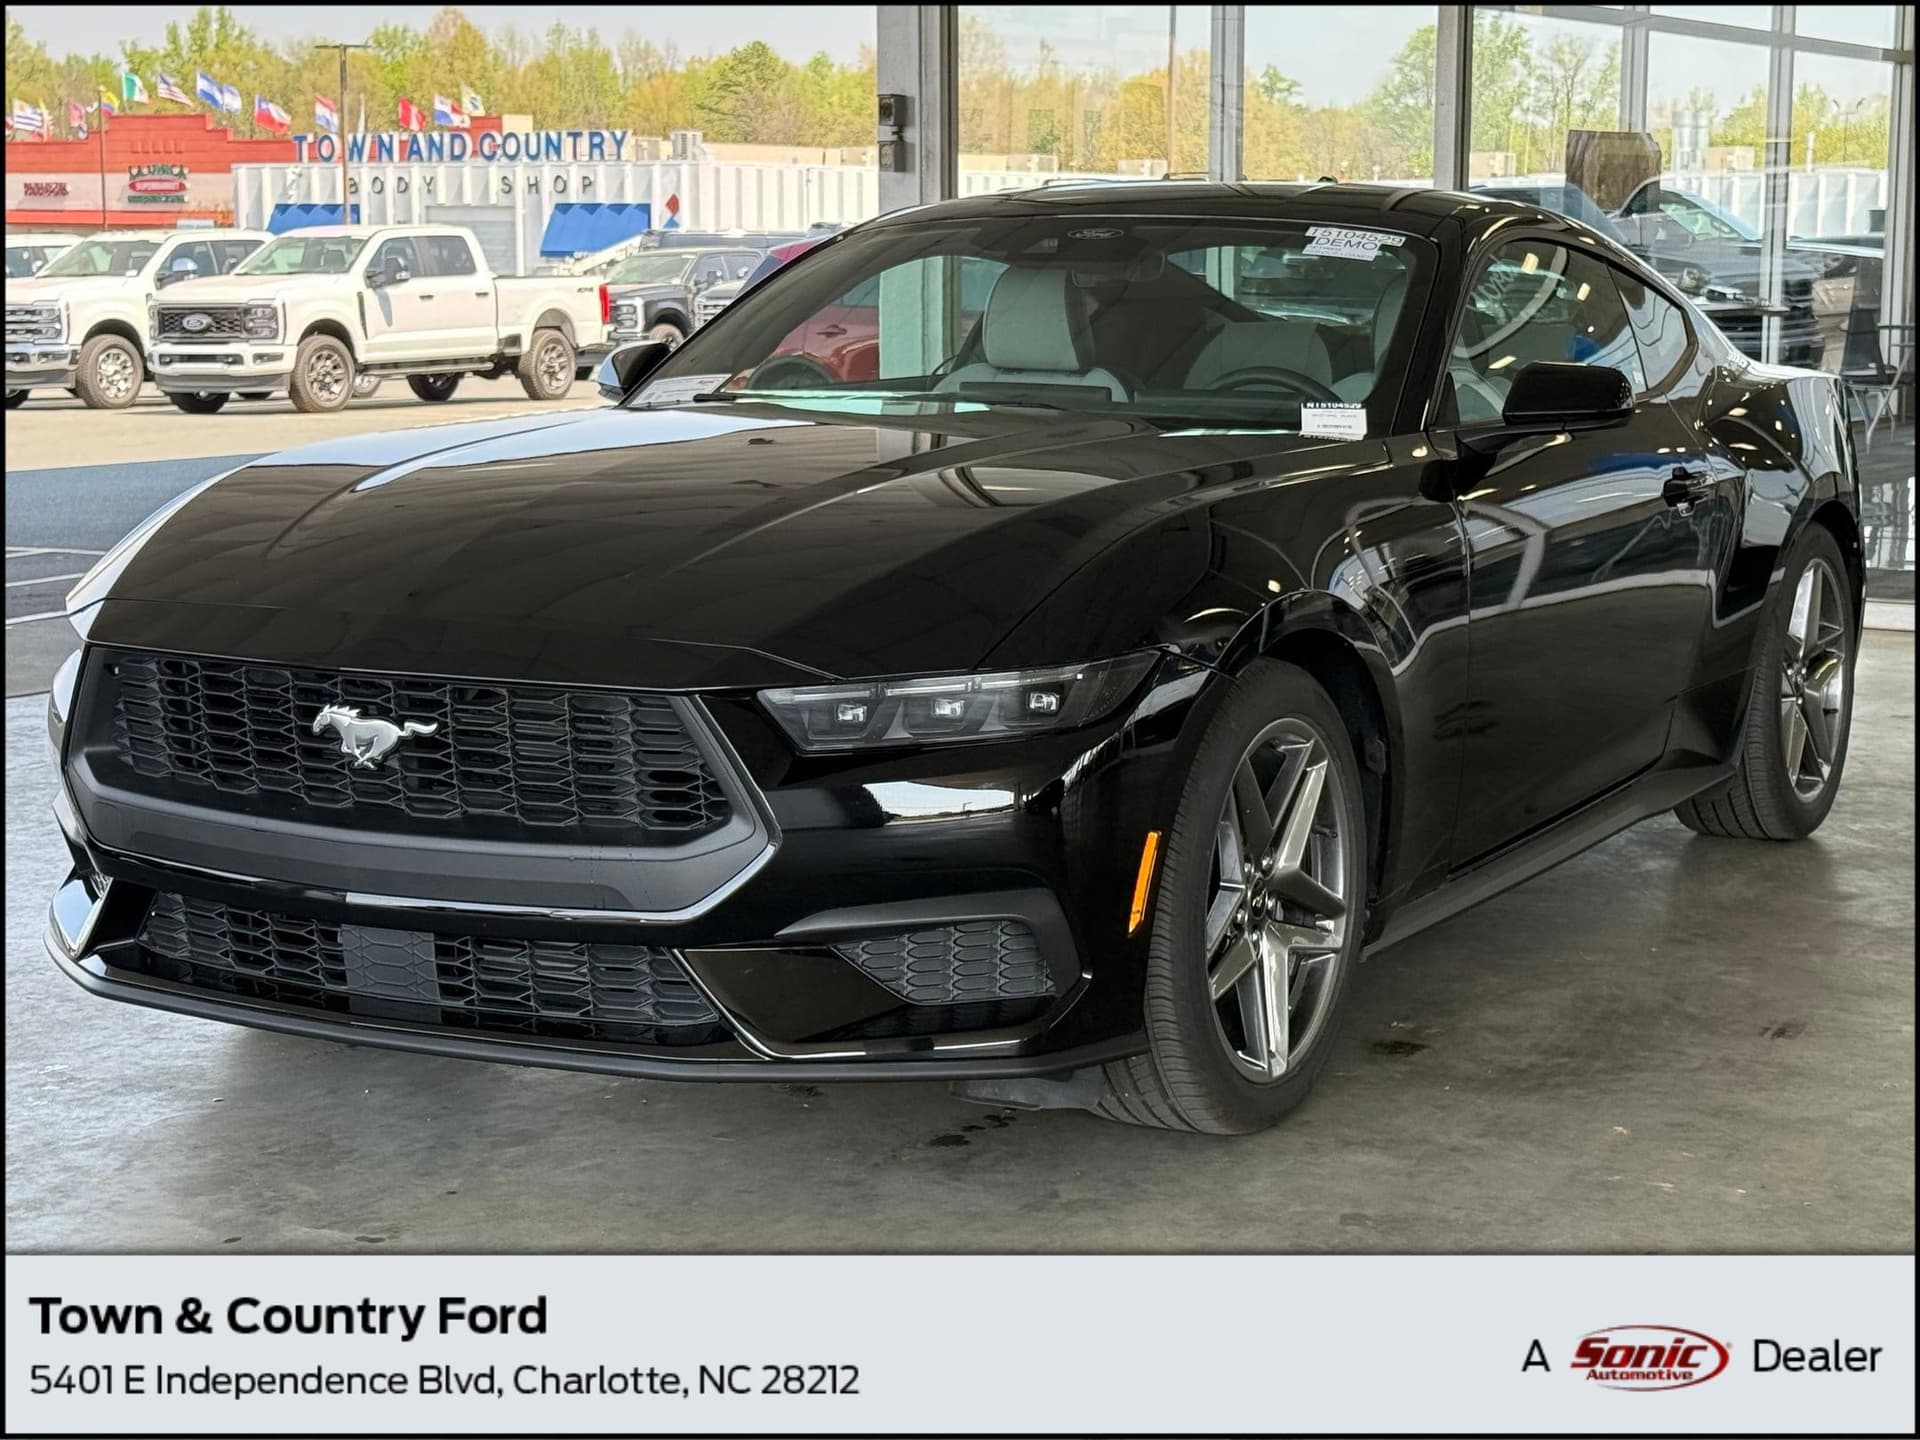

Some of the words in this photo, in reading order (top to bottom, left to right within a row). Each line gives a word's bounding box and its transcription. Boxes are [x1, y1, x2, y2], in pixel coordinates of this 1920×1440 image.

[293, 133, 394, 162] TOWN
[407, 132, 468, 161] AND
[479, 131, 628, 161] COUNTRY
[347, 175, 436, 196] BODY
[500, 175, 593, 196] SHOP
[1311, 227, 1403, 245] T5104529
[1314, 237, 1378, 251] DEMO
